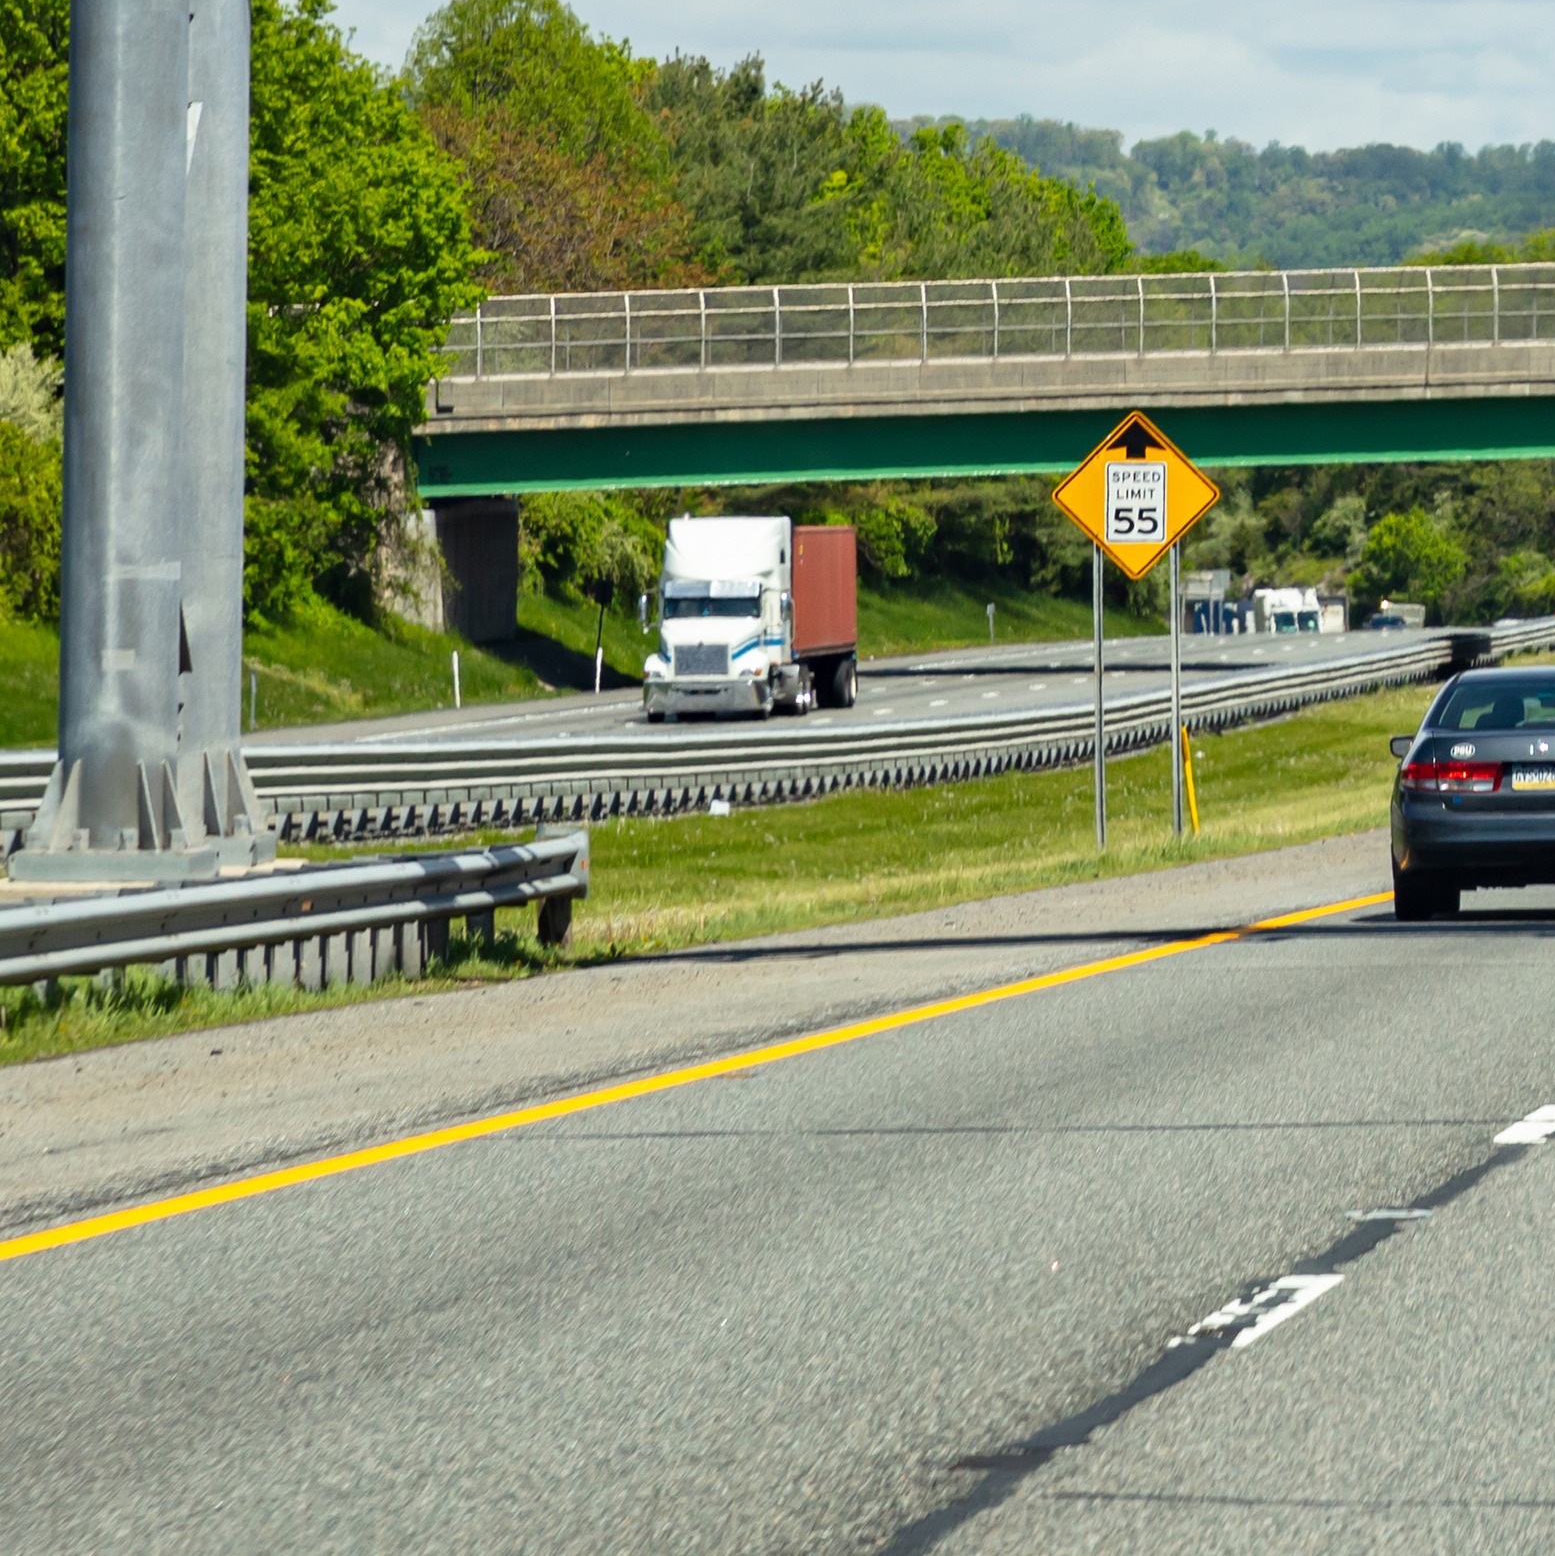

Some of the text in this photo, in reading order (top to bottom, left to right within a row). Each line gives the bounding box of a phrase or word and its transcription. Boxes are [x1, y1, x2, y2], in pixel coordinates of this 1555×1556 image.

[1112, 472, 1161, 483] SPEED
[1116, 488, 1155, 500] LIMIT
[1114, 507, 1158, 535] 55
